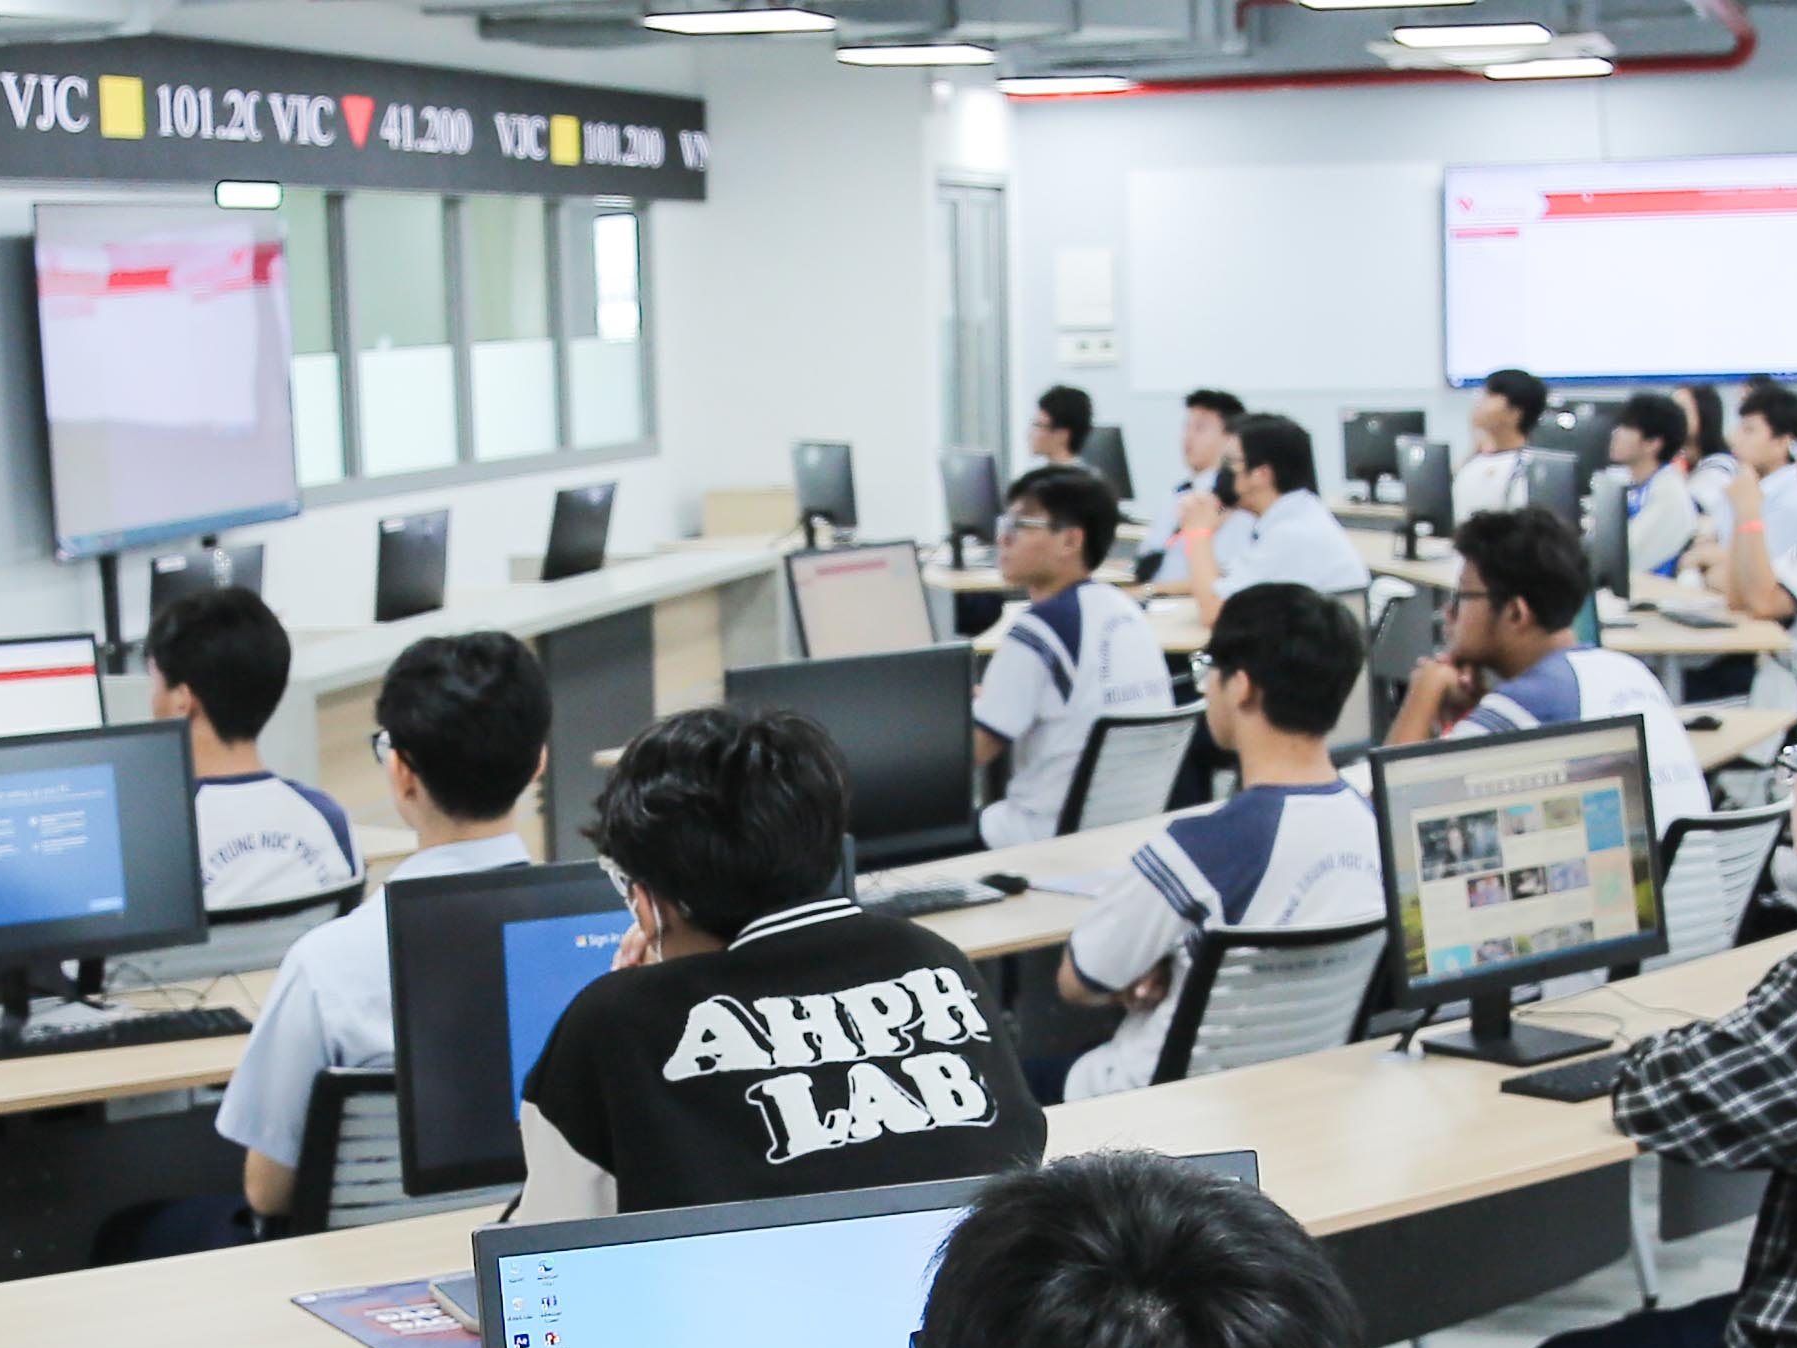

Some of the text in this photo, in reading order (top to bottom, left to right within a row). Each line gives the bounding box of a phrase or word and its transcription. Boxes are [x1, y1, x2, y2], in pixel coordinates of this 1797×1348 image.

[267, 92, 337, 147] VIC
[379, 103, 474, 155] 41.200
[662, 966, 992, 1082] AHPH
[745, 1051, 999, 1163] LAB
